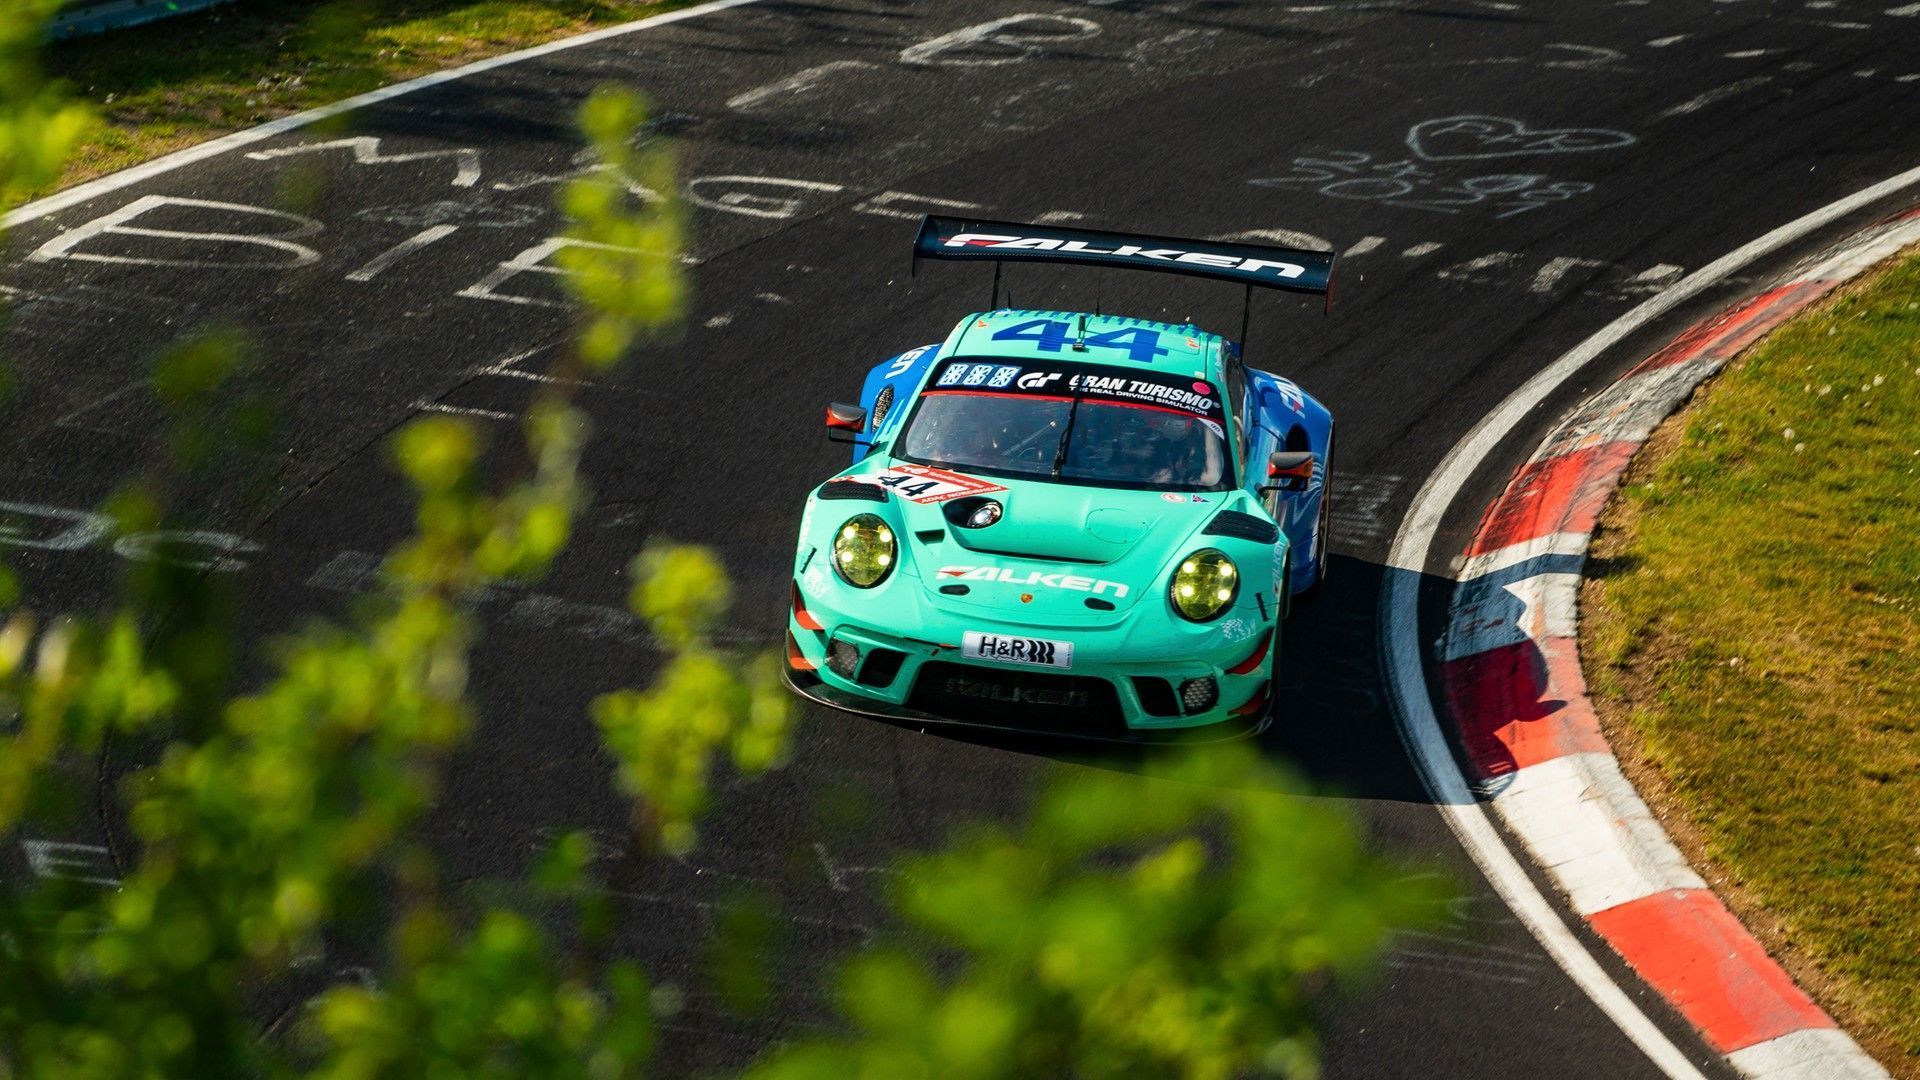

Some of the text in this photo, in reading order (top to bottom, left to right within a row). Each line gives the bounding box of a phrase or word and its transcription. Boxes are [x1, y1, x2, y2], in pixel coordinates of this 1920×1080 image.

[940, 233, 1305, 279] FALKEN
[991, 319, 1169, 363] 44
[1069, 374, 1126, 390] GRAN
[1090, 388, 1114, 396] REAL
[1116, 390, 1154, 401] DRIVING
[1156, 397, 1208, 416] SIMULATOR
[878, 475, 940, 496] 44
[936, 565, 1130, 598] FALKEN
